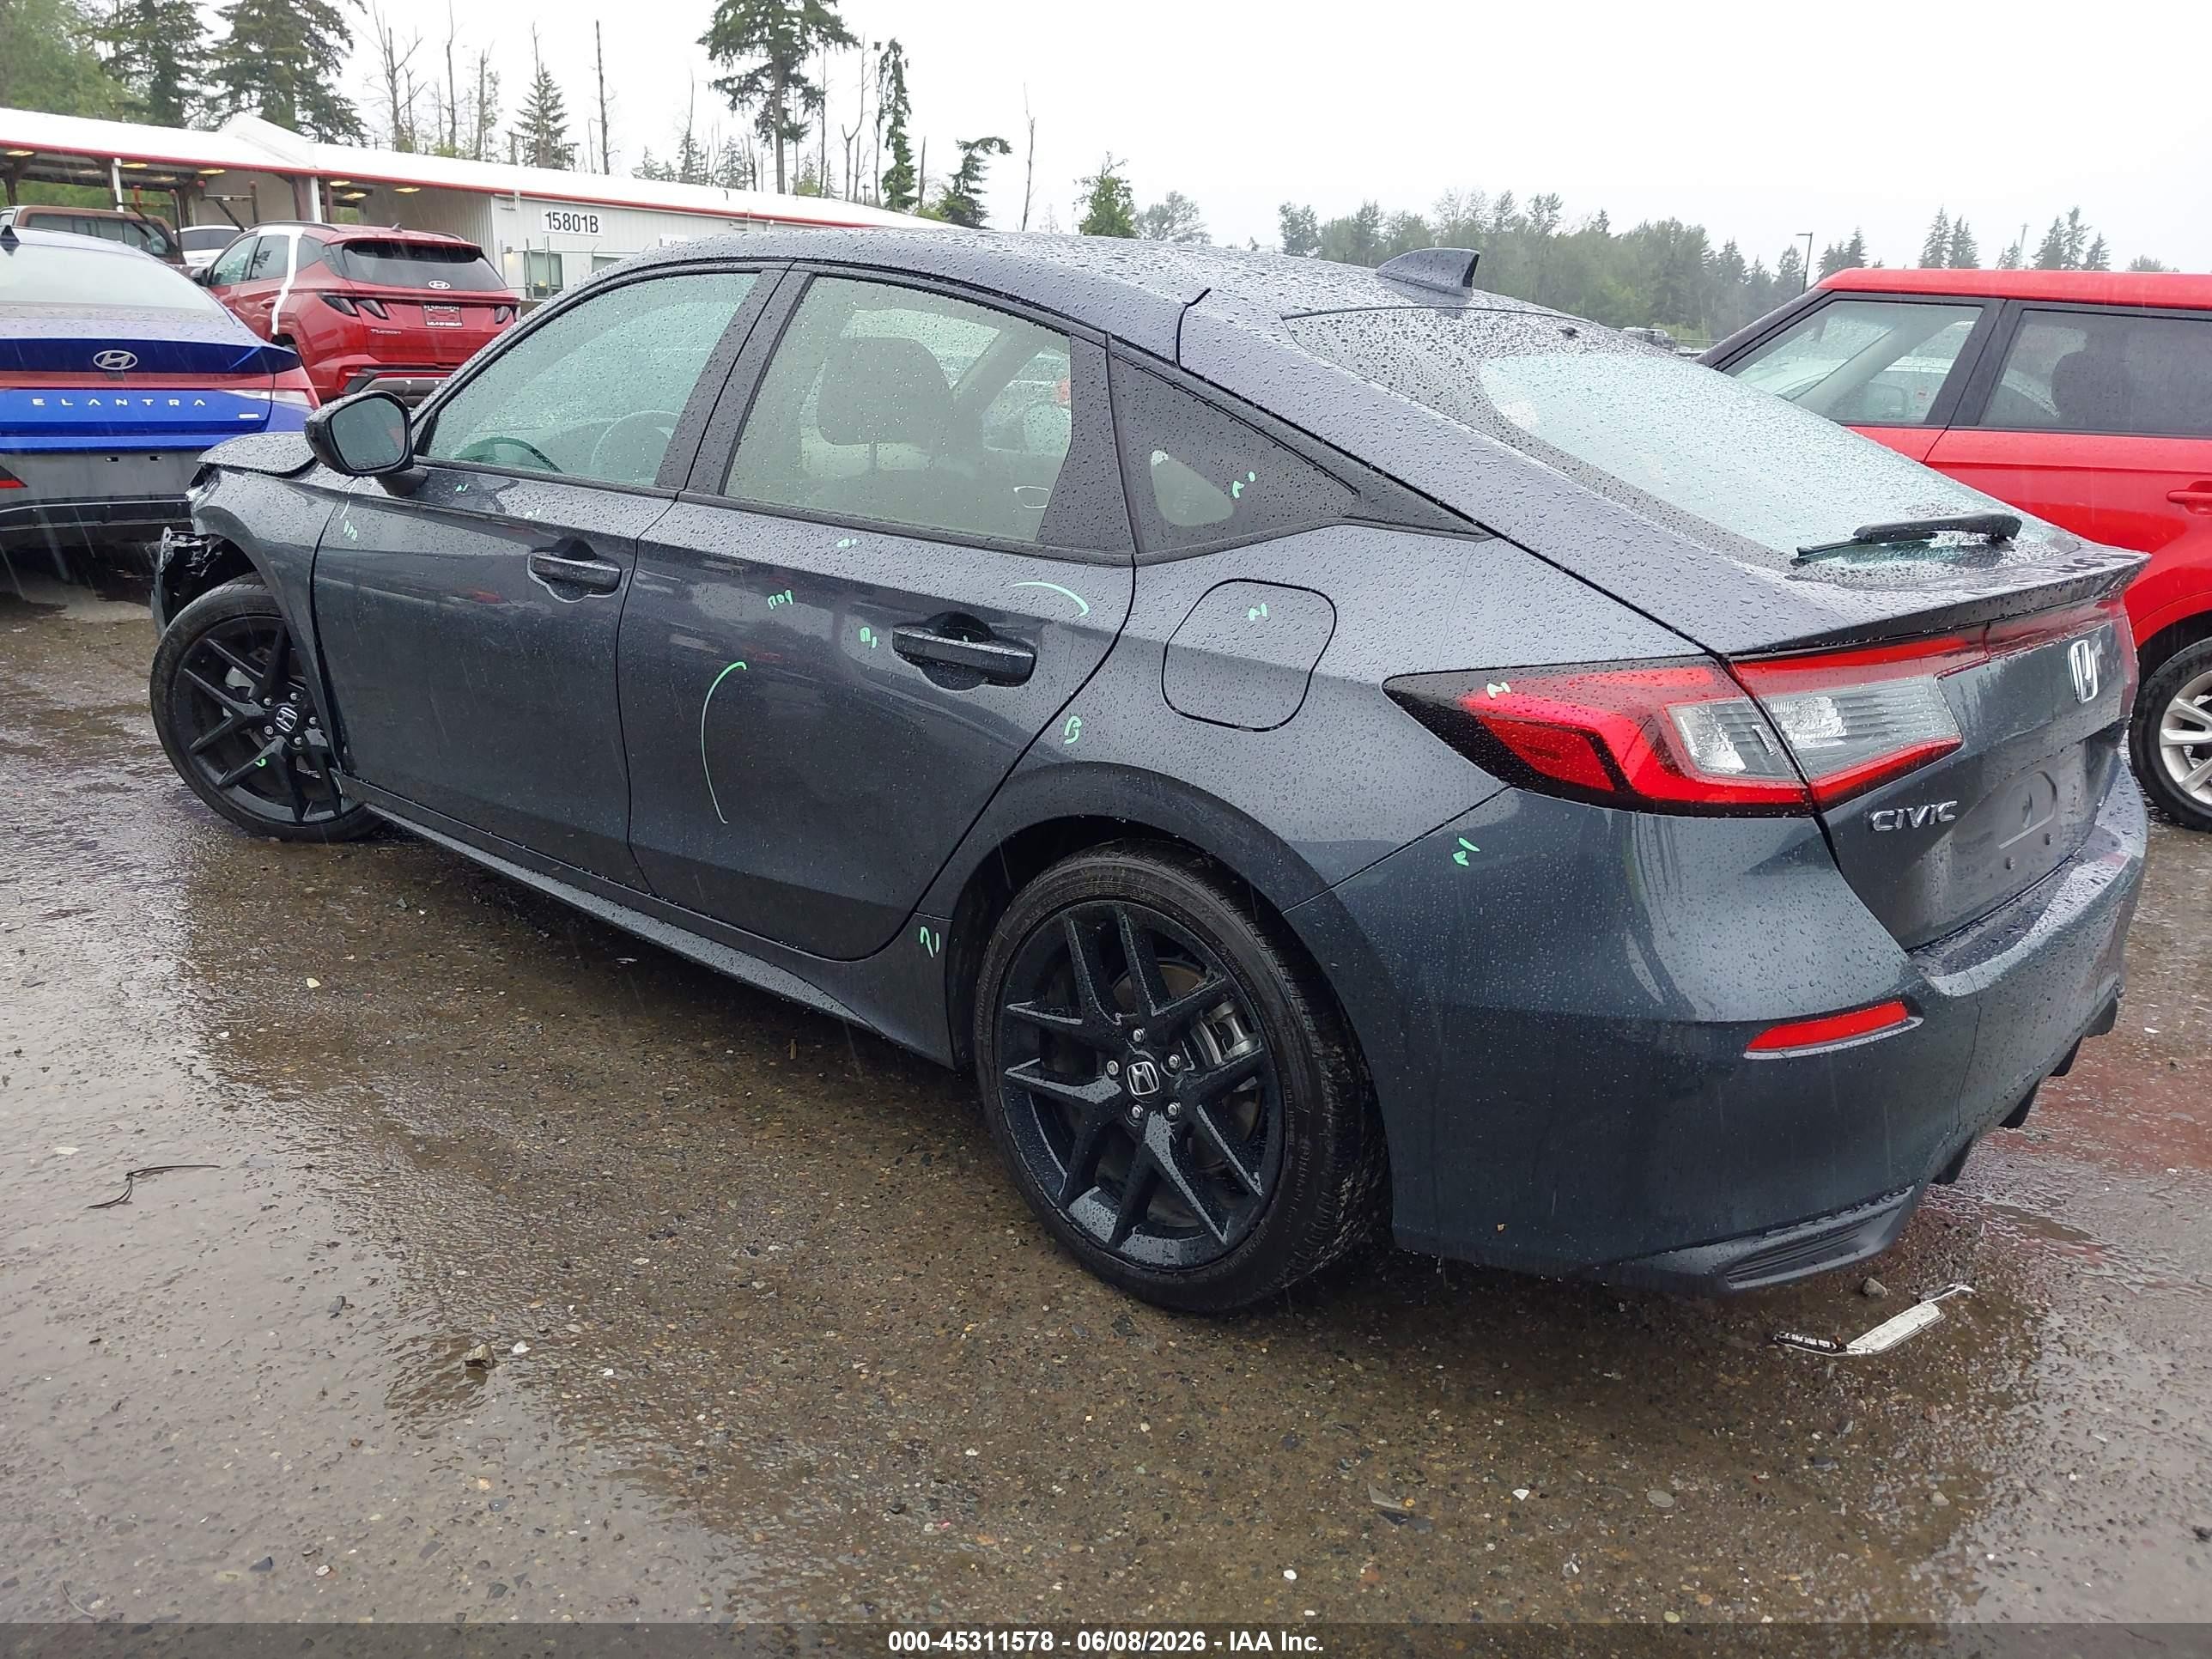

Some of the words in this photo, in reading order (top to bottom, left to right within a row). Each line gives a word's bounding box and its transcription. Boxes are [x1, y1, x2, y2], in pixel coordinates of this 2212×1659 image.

[544, 210, 599, 234] 15801B
[32, 398, 206, 406] ELANTRA
[1871, 800, 1958, 831] CIVIC
